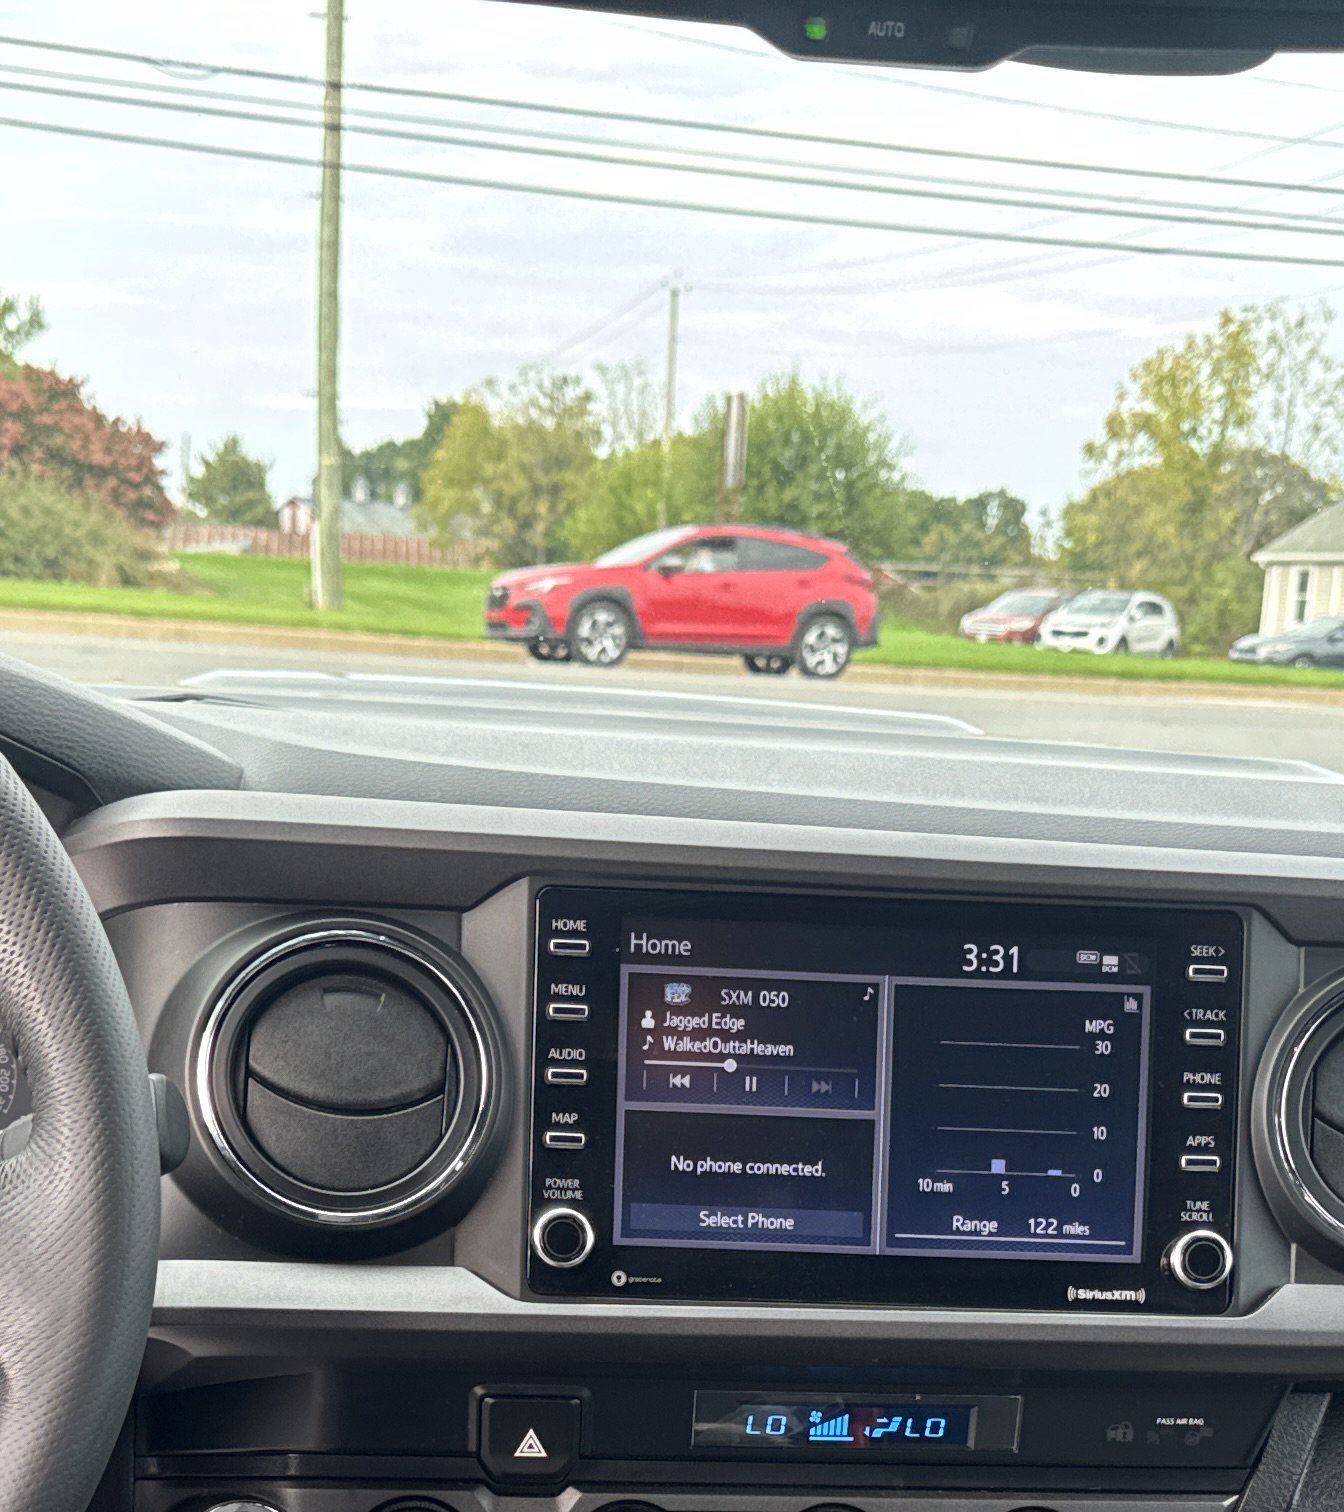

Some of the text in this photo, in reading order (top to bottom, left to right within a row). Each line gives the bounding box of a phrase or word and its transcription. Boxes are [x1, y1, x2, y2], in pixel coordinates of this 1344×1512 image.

[868, 21, 904, 38] AUTO
[552, 919, 587, 932] HOME
[630, 932, 692, 956] Home
[962, 943, 1020, 974] 3:31
[550, 984, 586, 997] MENU
[720, 989, 790, 1008] SXM 050
[663, 1011, 746, 1032] Jagged Edge
[1085, 1020, 1115, 1035] MPG
[548, 1047, 586, 1060] AUDIO
[662, 1035, 795, 1058] WalkedOuttaHeaven
[1094, 1041, 1112, 1055] 30
[1183, 1072, 1222, 1085] PHONE
[1093, 1083, 1110, 1098] 20
[552, 1112, 578, 1124] MAP
[1092, 1126, 1107, 1140] 10
[1186, 1136, 1215, 1148] APPS
[670, 1155, 827, 1178] No phone connected.
[1093, 1168, 1103, 1183] 0
[545, 1177, 580, 1189] POWER
[918, 1178, 954, 1194] 10 min
[1001, 1181, 1009, 1195] 5
[543, 1189, 584, 1201] VOLUME
[1070, 1183, 1080, 1198] 0
[1186, 1200, 1211, 1211] TUNE
[699, 1210, 795, 1231] Select Phone
[1181, 1211, 1214, 1222] SCROLL
[952, 1215, 1090, 1237] Range 122 miles
[1156, 1418, 1175, 1426] PASS
